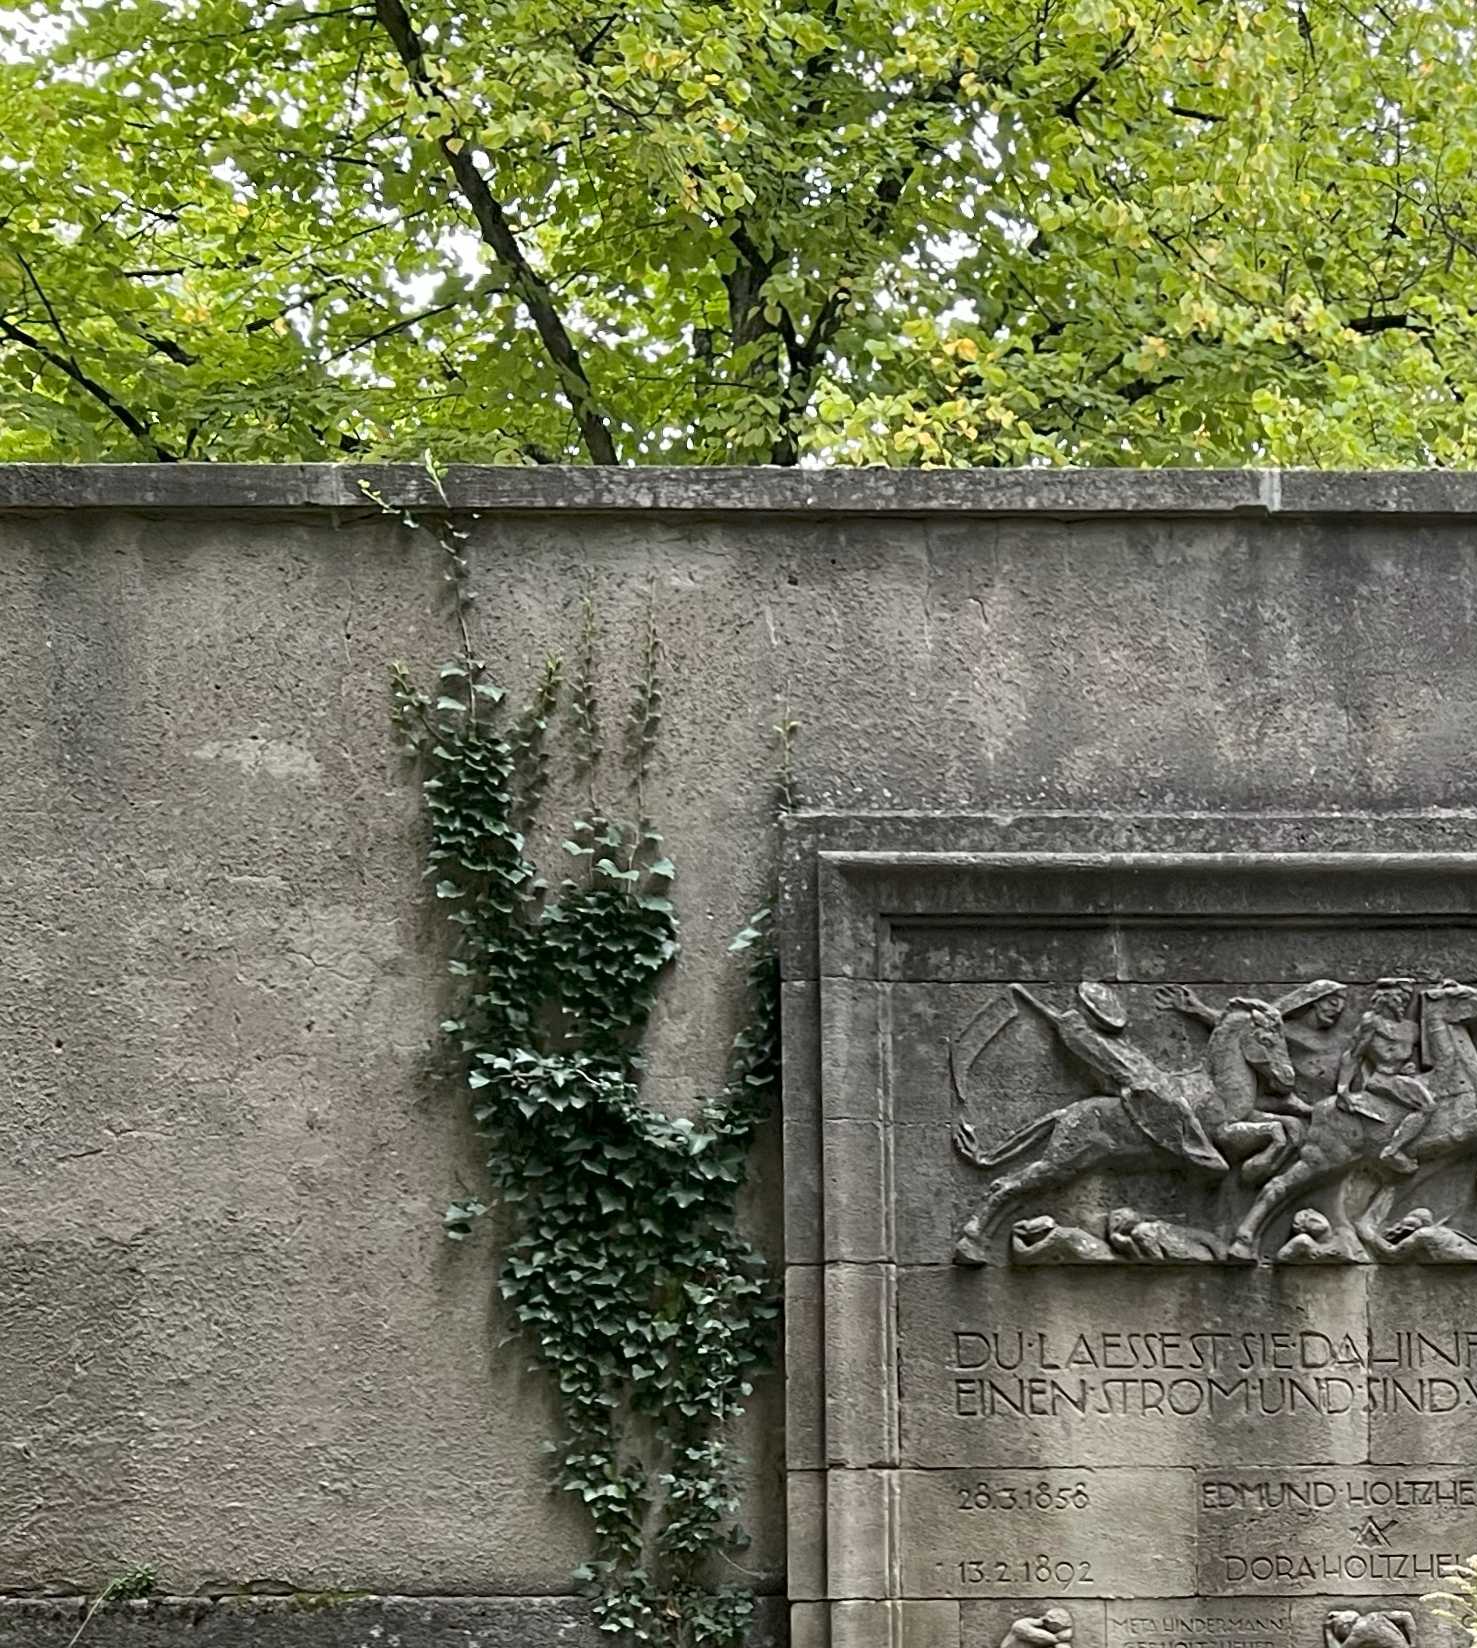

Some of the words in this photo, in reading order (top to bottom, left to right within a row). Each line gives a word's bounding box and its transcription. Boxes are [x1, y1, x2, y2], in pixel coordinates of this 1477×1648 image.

[953, 1330, 1023, 1370] DU
[1038, 1331, 1231, 1370] LAESSEST
[1238, 1331, 1294, 1369] SIE
[953, 1377, 1088, 1420] EINEN
[1095, 1376, 1250, 1418] STROM
[1258, 1375, 1355, 1415] UND
[1364, 1375, 1461, 1415] SIND
[1202, 1481, 1337, 1509] EDMUND
[1223, 1554, 1317, 1582] DORA
